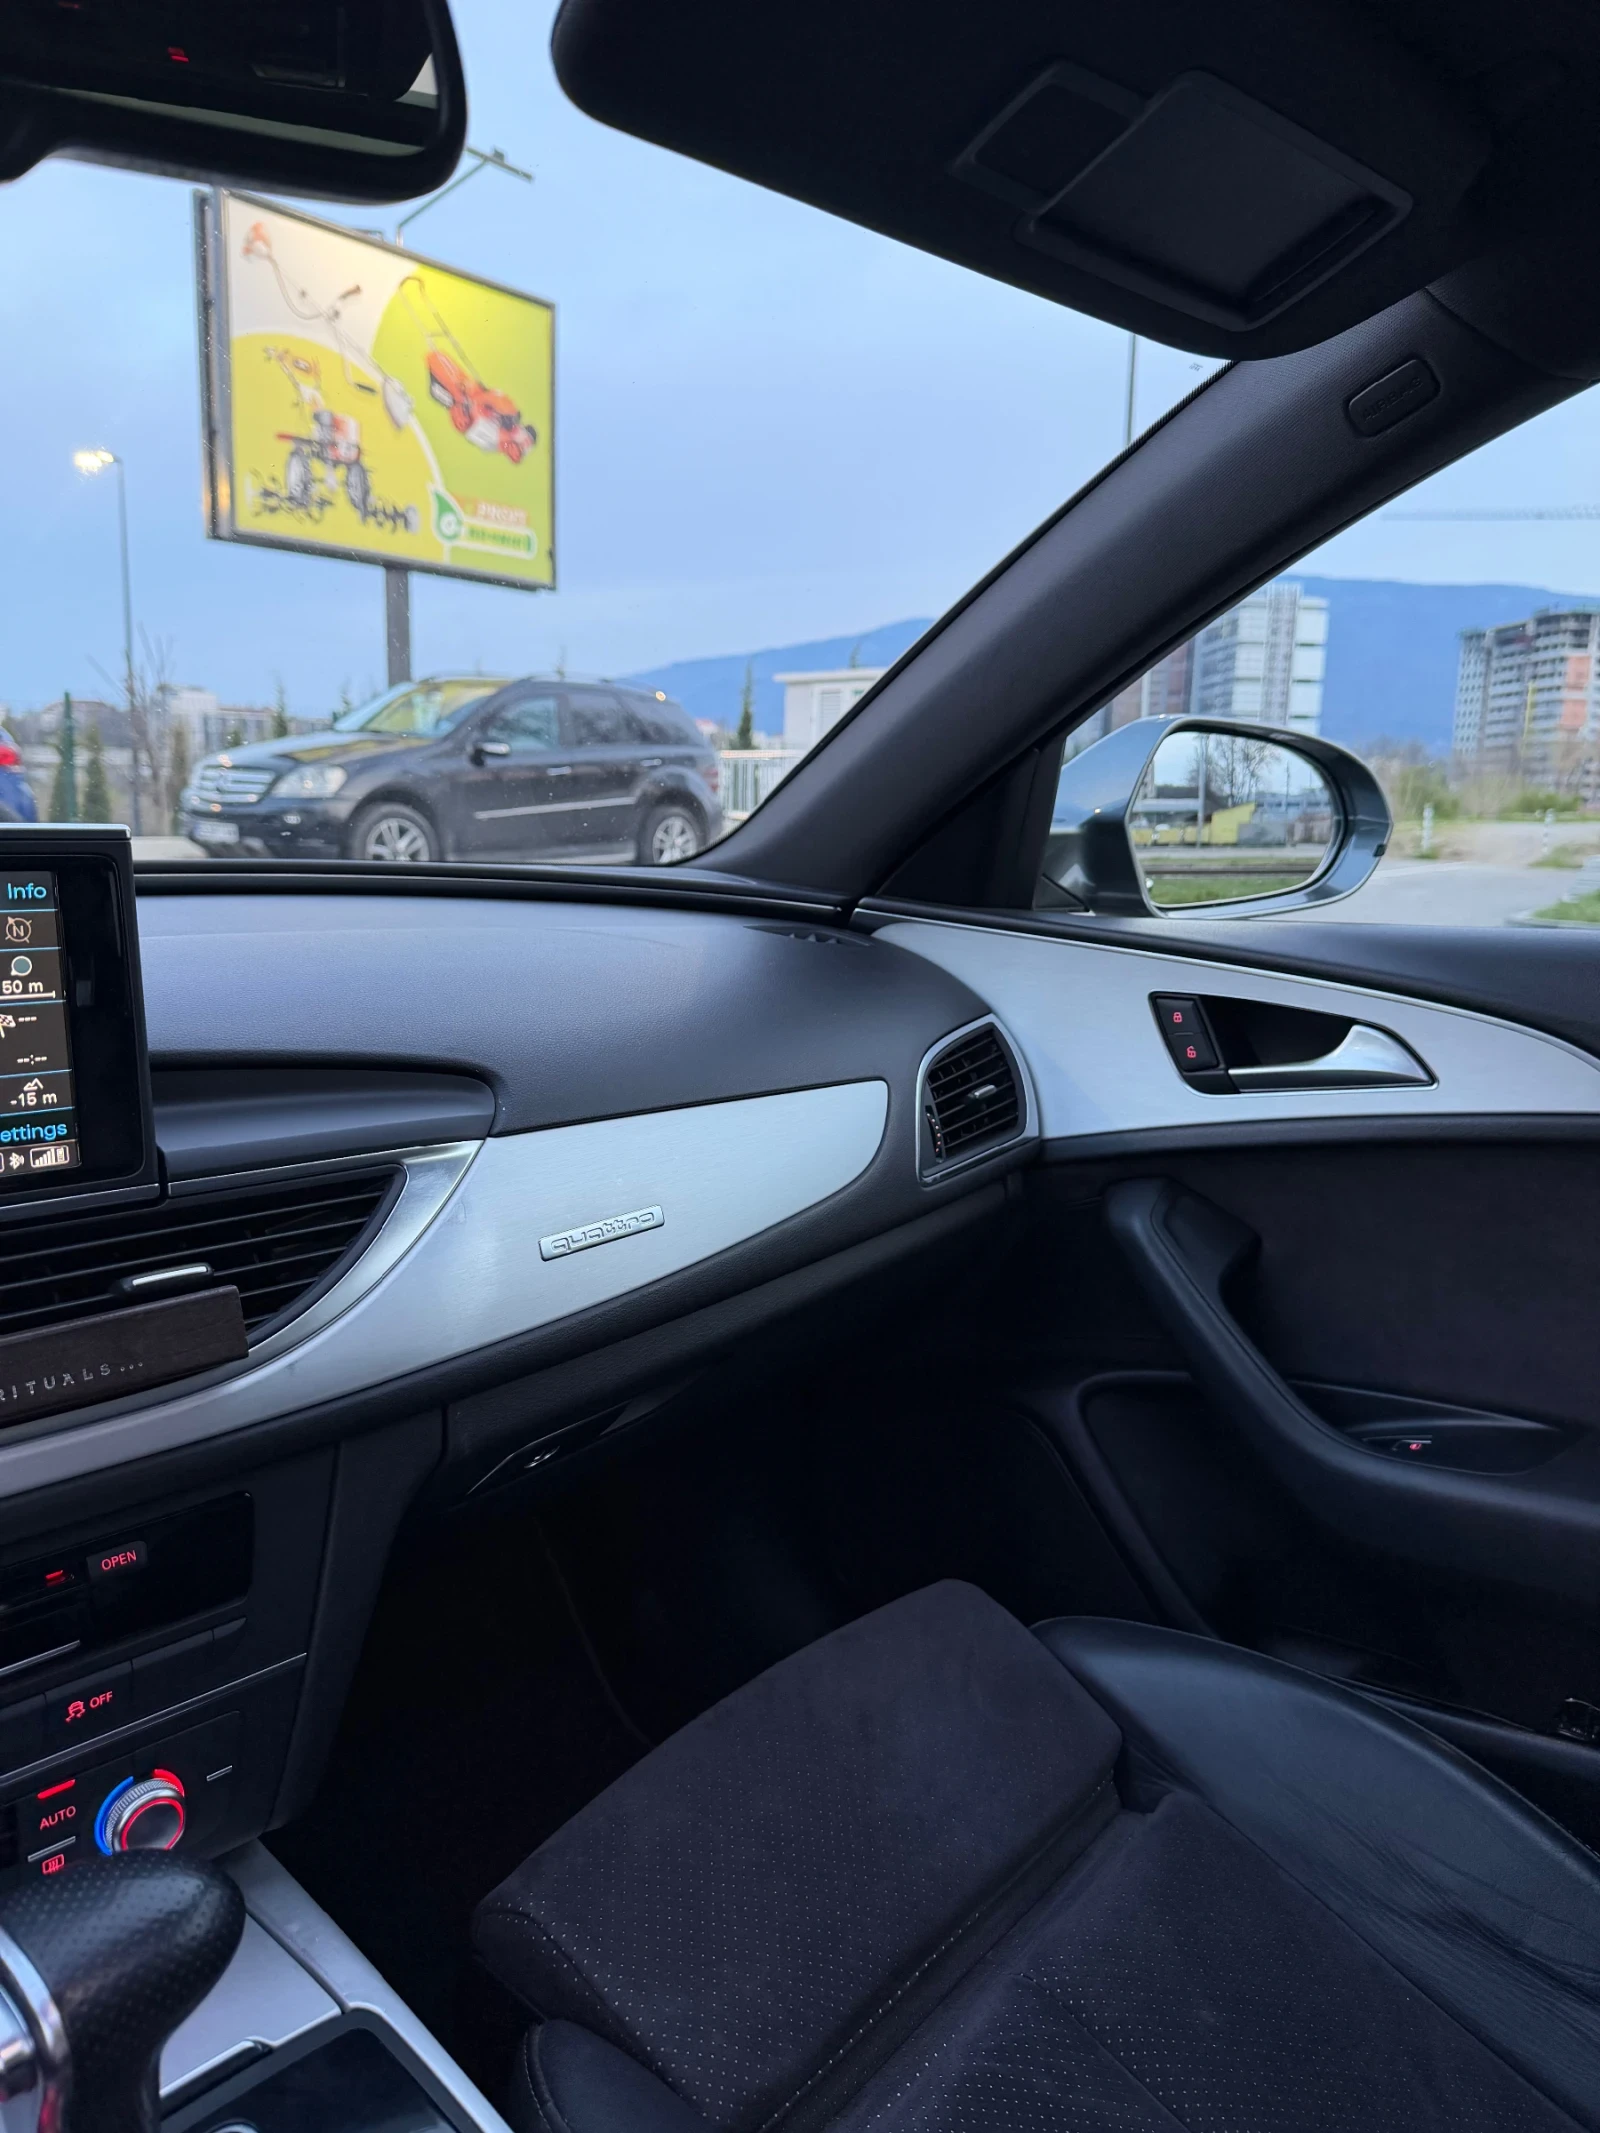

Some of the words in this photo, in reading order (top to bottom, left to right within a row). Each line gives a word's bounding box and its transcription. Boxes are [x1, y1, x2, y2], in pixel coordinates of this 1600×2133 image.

[7, 882, 47, 900] Info
[2, 979, 23, 994] 50
[28, 981, 44, 993] m
[9, 1091, 38, 1108] -15
[42, 1092, 58, 1105] m
[550, 1211, 655, 1252] quattro
[101, 1549, 137, 1571] OPEN
[89, 1690, 113, 1709] OFF
[39, 1805, 77, 1831] AUTO
